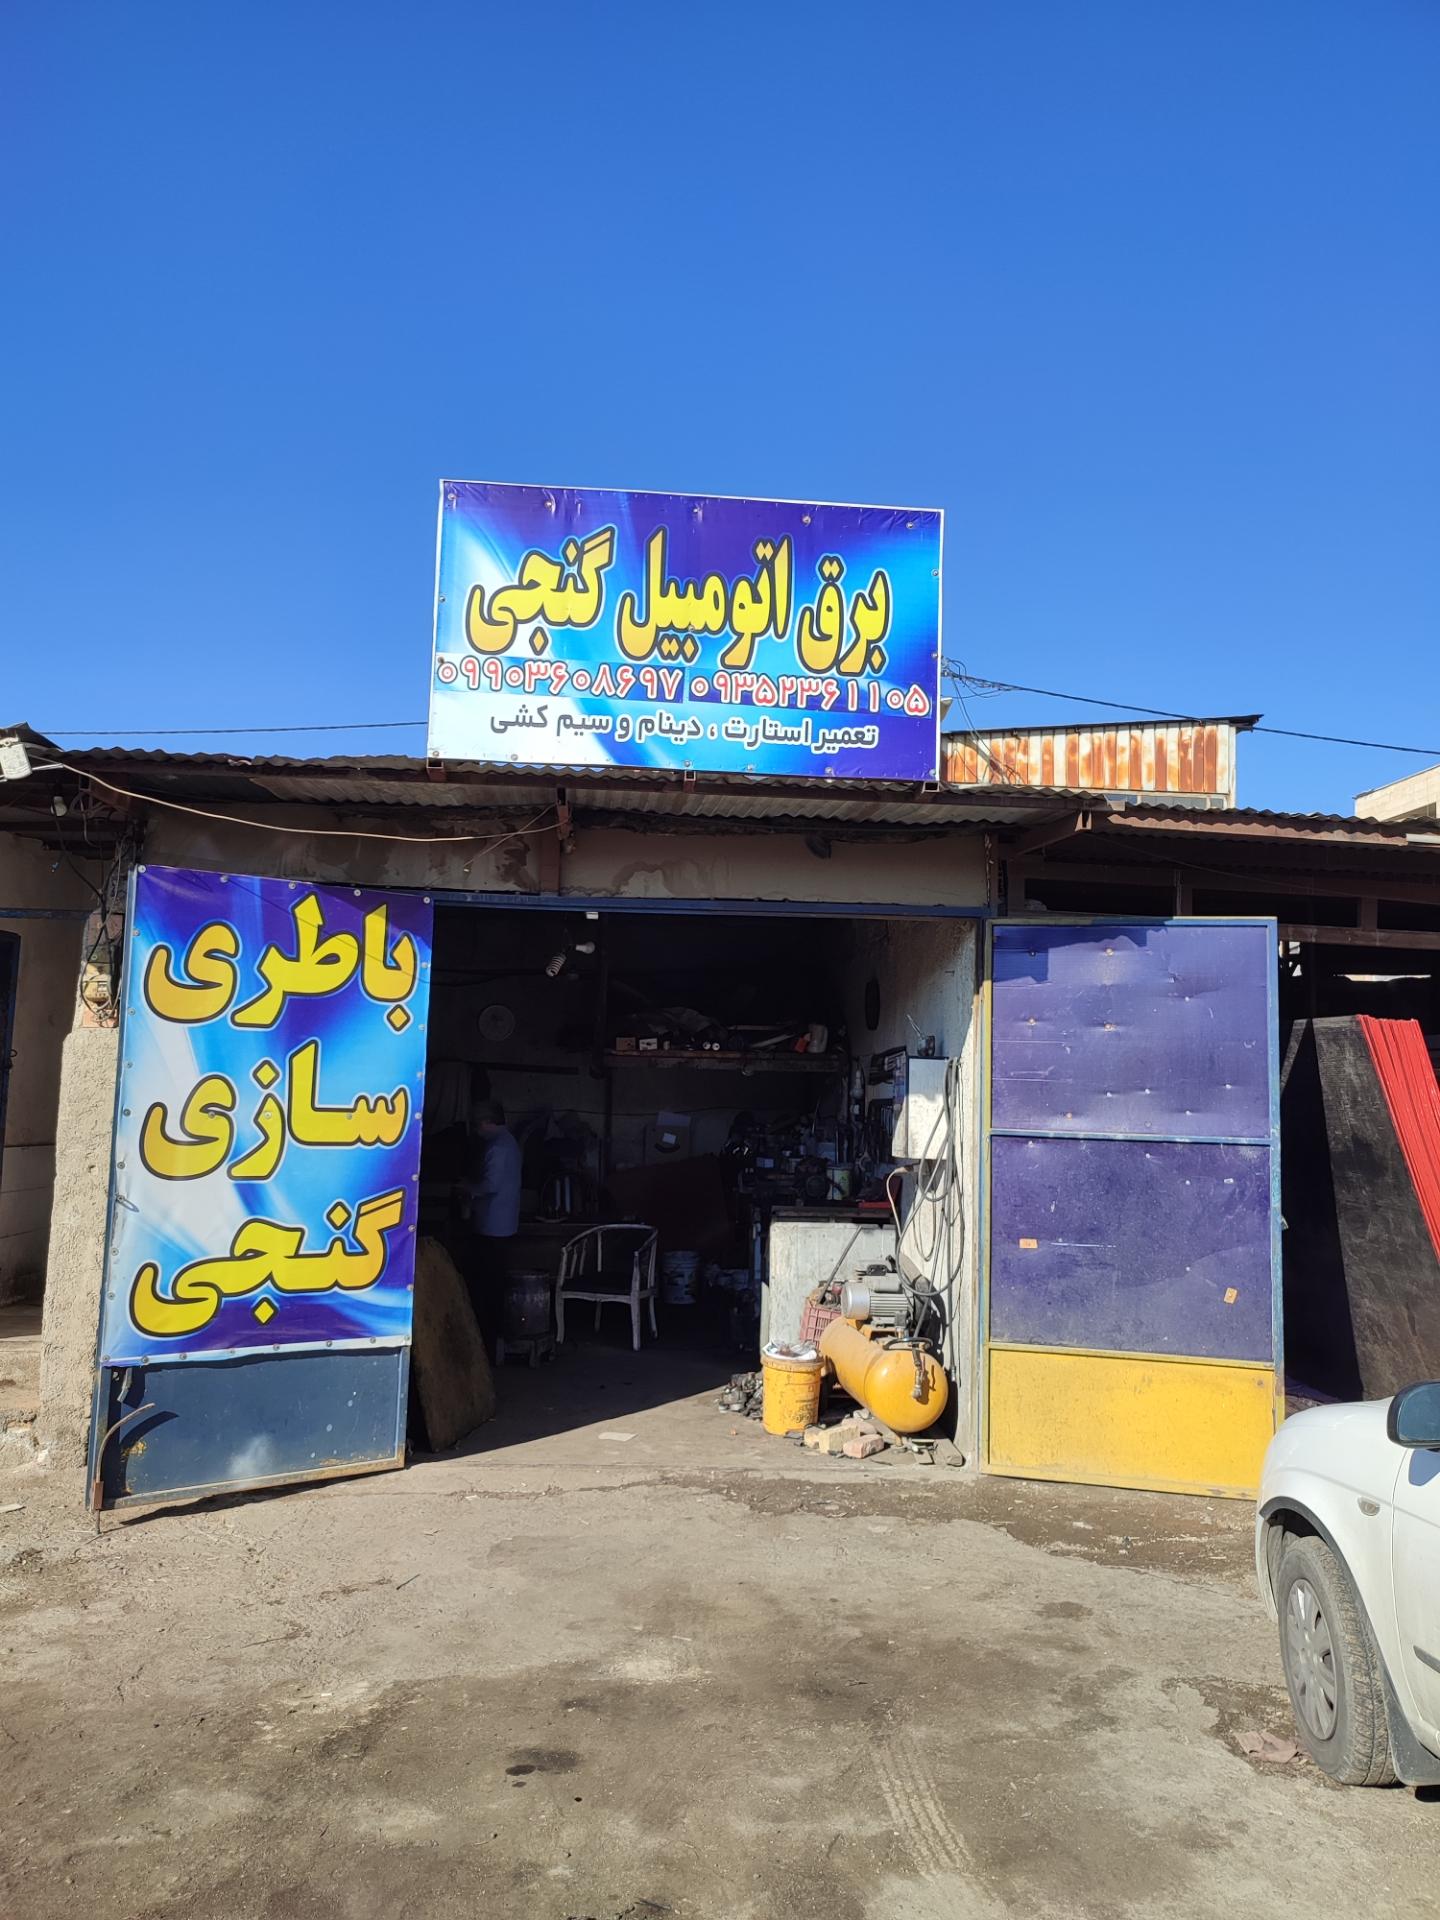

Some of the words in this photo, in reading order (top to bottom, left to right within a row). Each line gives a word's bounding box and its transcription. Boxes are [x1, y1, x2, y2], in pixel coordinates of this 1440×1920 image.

[466, 525, 616, 655] گنجی
[618, 526, 793, 669] اتومبیل
[798, 556, 890, 675] برق
[438, 655, 683, 700] ۰۹۹۰۳۶۰۸۶۹۷
[691, 671, 931, 716] ۰۹۳۵۲۳۶۱۱۰۵
[490, 704, 548, 734] کشی
[556, 713, 610, 737] سیم
[616, 717, 630, 739] و
[638, 712, 701, 742] دینام
[724, 718, 810, 747] استارت
[813, 726, 877, 751] تعمیر
[144, 891, 417, 1032] باطری
[139, 1038, 411, 1181] سازی
[129, 1188, 405, 1338] گنجی
